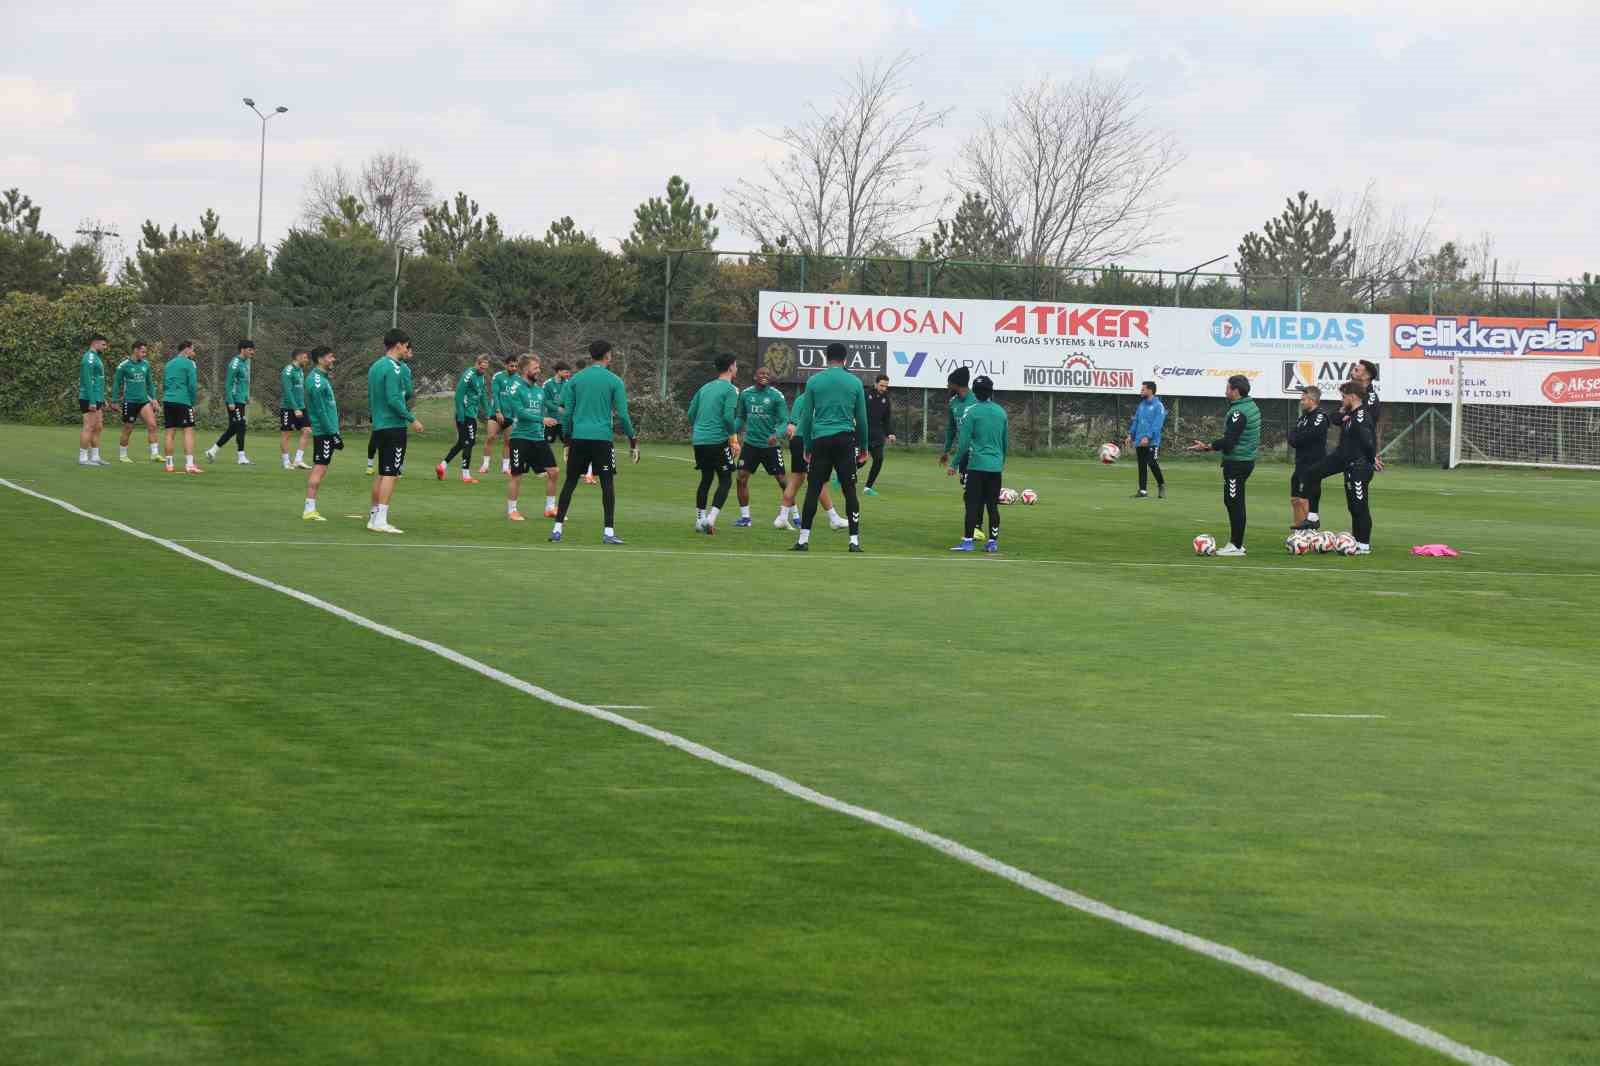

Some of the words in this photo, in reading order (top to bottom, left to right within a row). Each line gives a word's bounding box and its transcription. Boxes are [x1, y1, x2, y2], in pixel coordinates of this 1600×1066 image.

[803, 301, 964, 335] TÜMOSAN
[1250, 315, 1365, 347] MEDAŞ
[995, 336, 1041, 345] AUTOGAS
[1043, 337, 1086, 347] SYSTEMS
[1098, 339, 1115, 348] LPG
[1118, 340, 1150, 349] TANKS
[798, 348, 881, 369] UYAL
[1317, 361, 1381, 381] AYA
